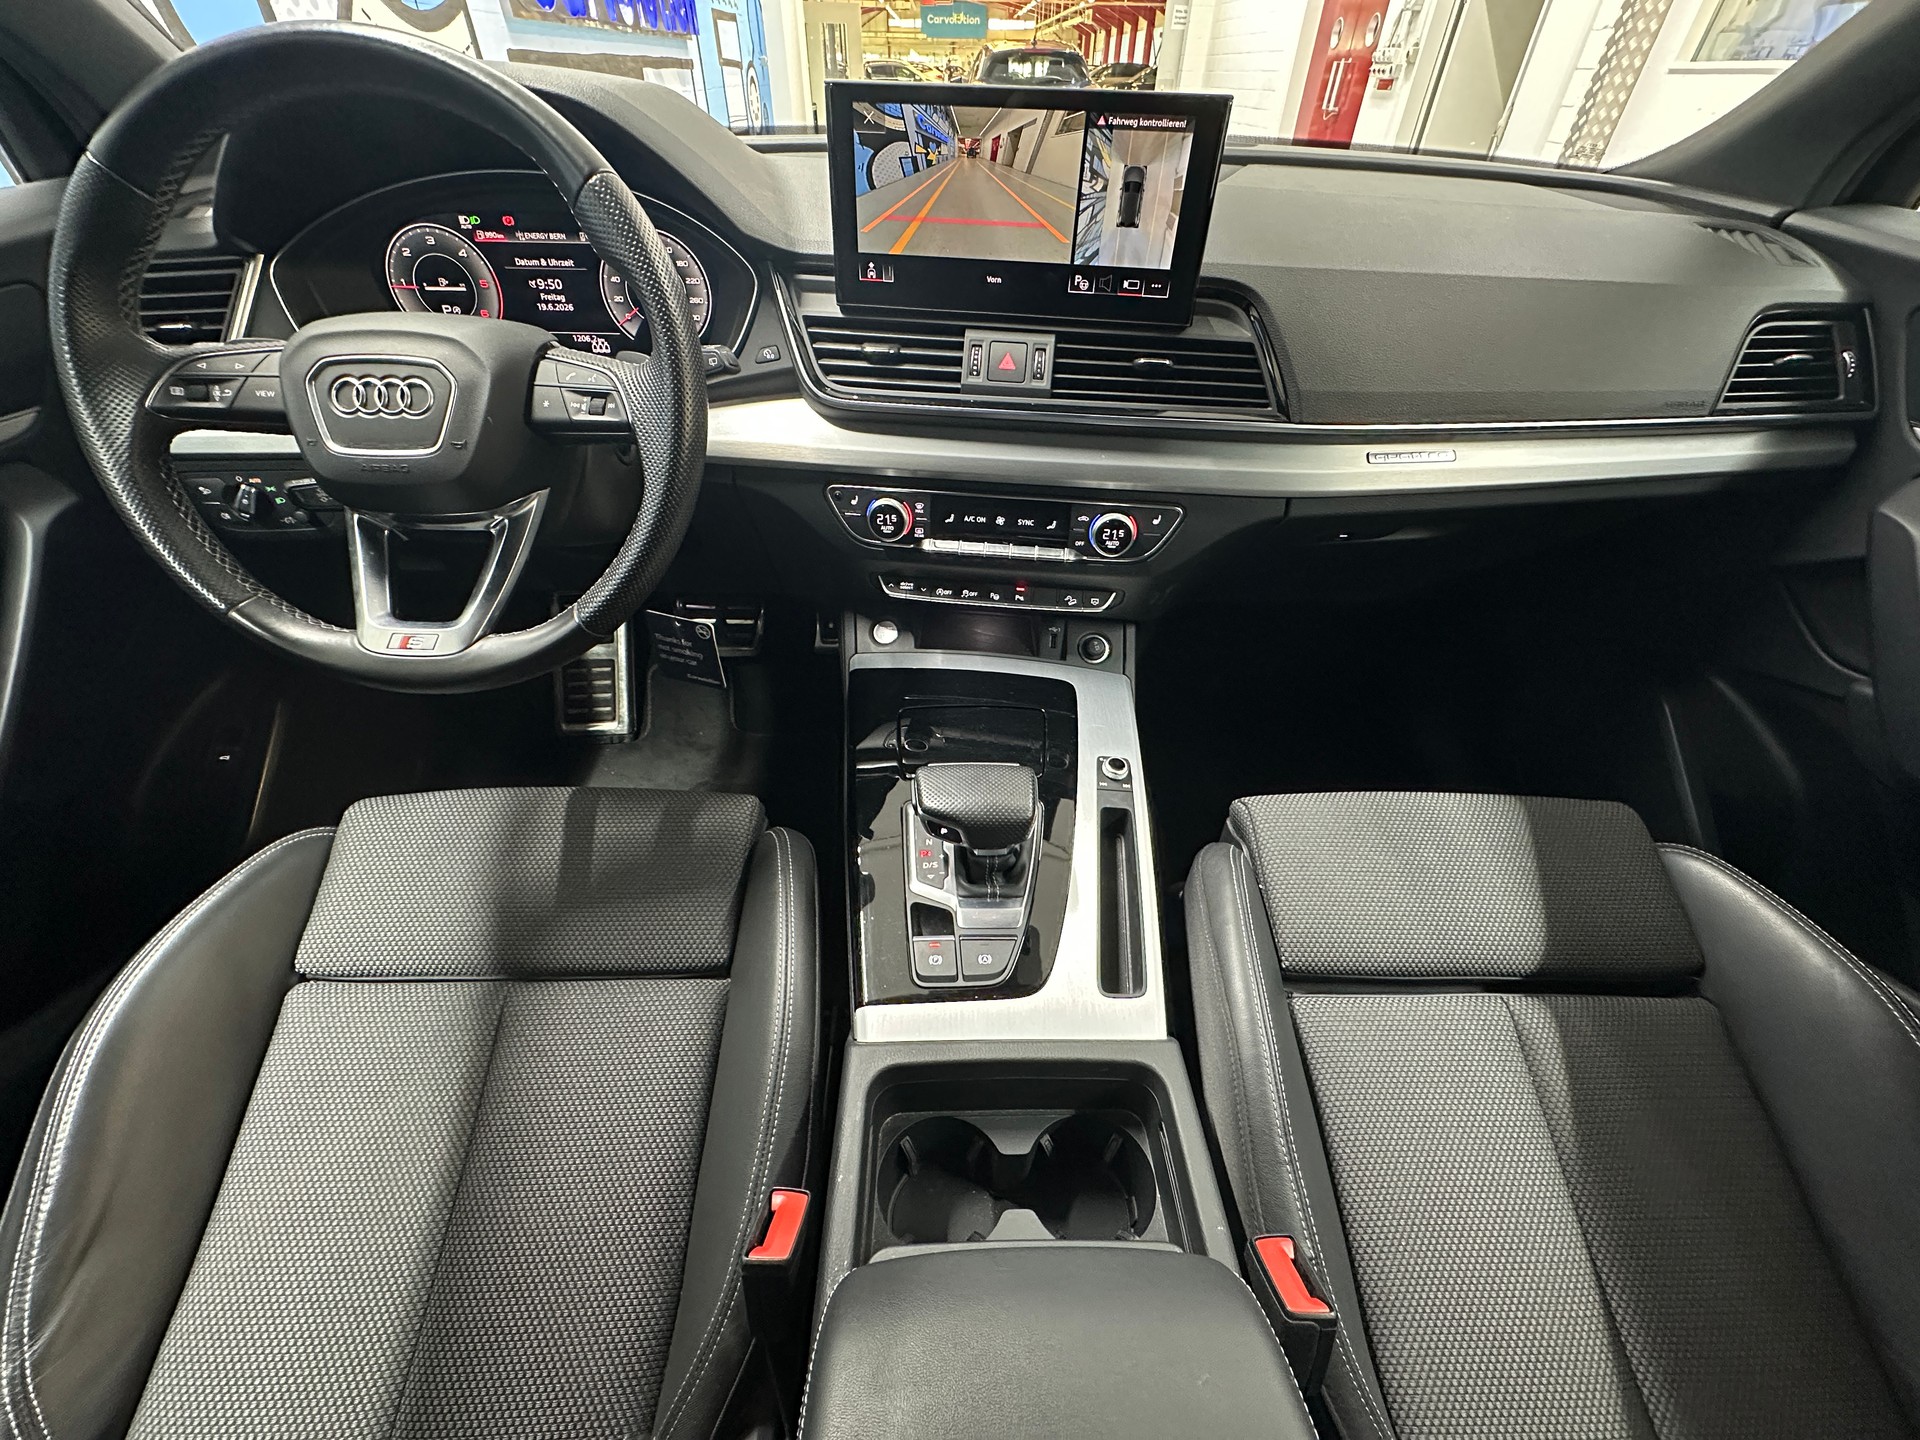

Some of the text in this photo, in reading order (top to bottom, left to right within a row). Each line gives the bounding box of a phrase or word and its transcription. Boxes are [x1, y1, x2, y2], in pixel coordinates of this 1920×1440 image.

[1108, 117, 1187, 128] Fahrweg kontrollieren!
[485, 231, 497, 239] 990
[525, 232, 548, 240] ENERGY
[425, 236, 436, 245] 3
[401, 247, 412, 257] 2
[458, 248, 468, 258] 4
[514, 257, 575, 267] Datum & Uhrzeit
[479, 279, 489, 288] 5
[536, 278, 563, 290] 9:50
[685, 277, 700, 285] 220
[986, 275, 1002, 284] Vorn
[540, 293, 566, 303] Freitag
[614, 295, 624, 303] 20
[536, 303, 575, 312] 19.6.2026
[255, 390, 276, 398] VIEW
[876, 514, 897, 525] 21.5
[963, 515, 976, 523] A/C
[1017, 518, 1035, 526] SYNC
[1102, 528, 1125, 541] 21.5
[925, 838, 933, 846] N
[922, 861, 939, 869] D/S
